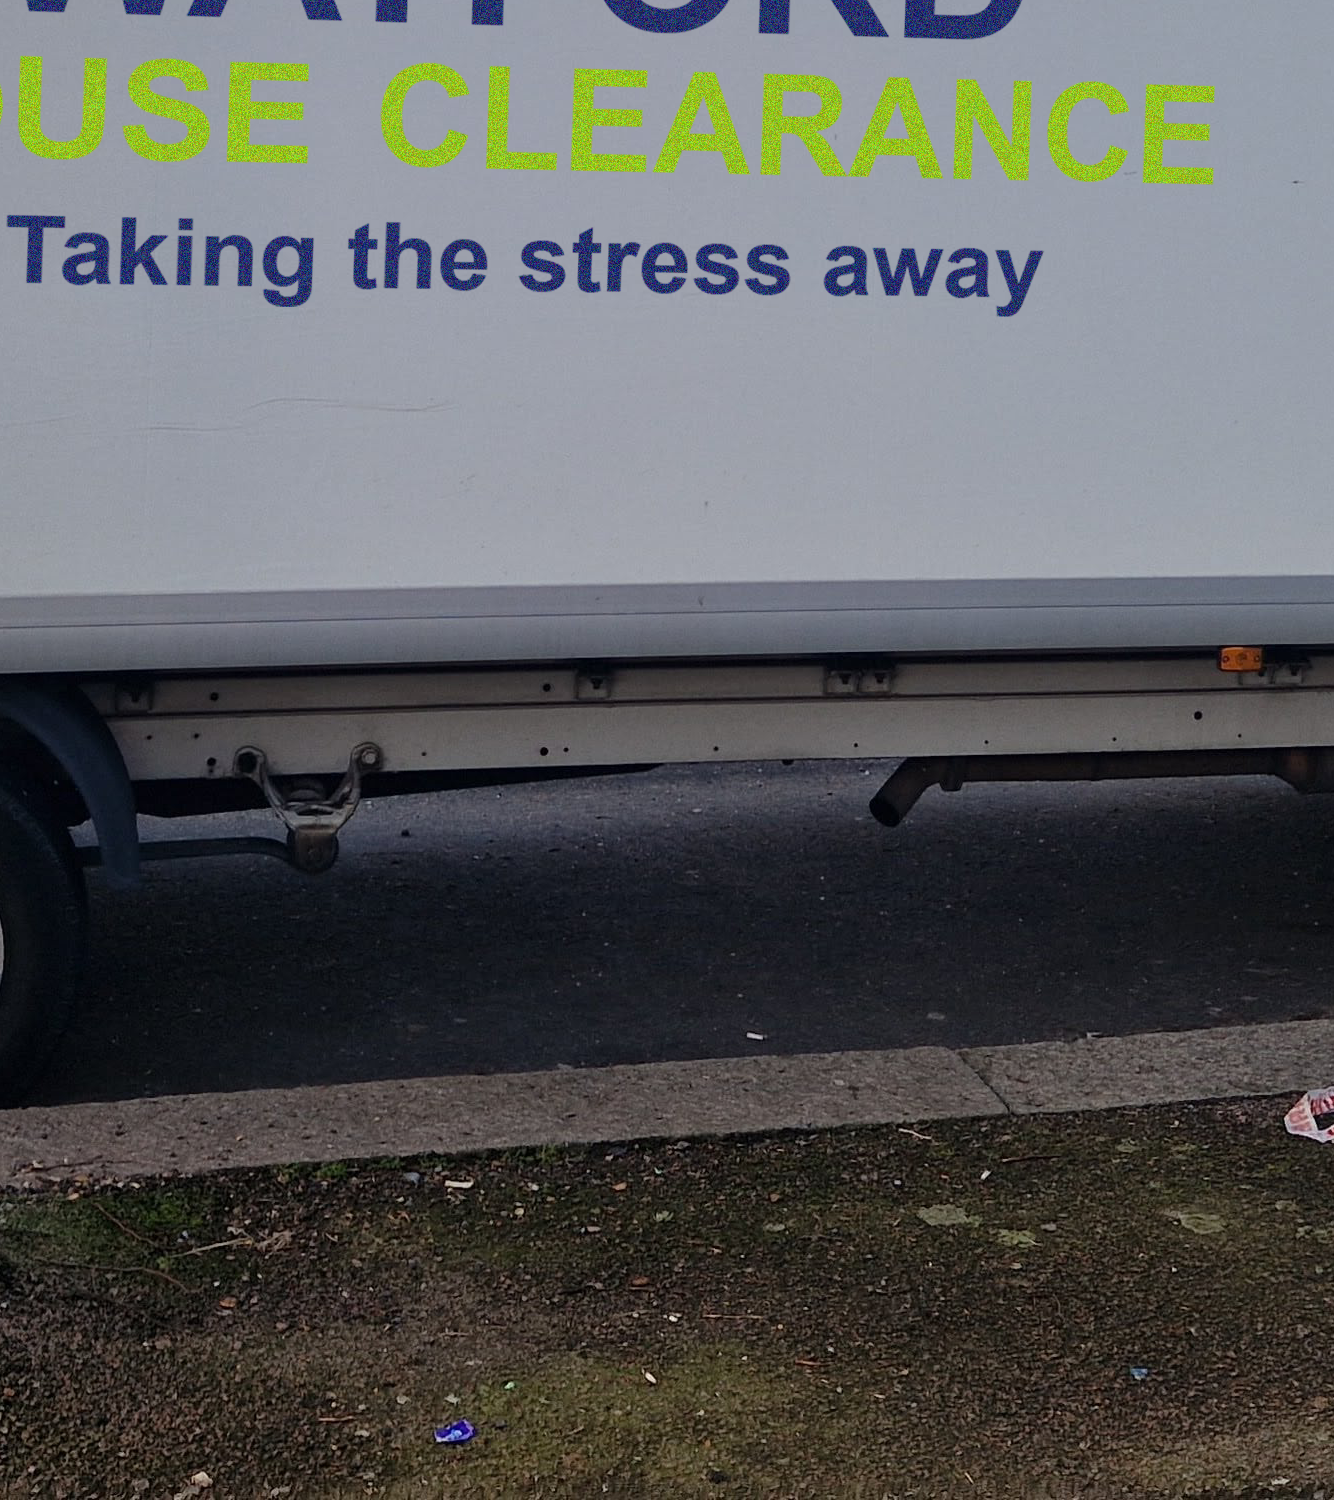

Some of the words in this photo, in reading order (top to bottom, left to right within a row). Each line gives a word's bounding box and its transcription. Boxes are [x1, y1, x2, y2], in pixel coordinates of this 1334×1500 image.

[380, 62, 1216, 185] CLEARANCE
[7, 215, 314, 307] Taking
[348, 222, 488, 291] the
[519, 228, 790, 295] stress
[823, 246, 1043, 317] away
